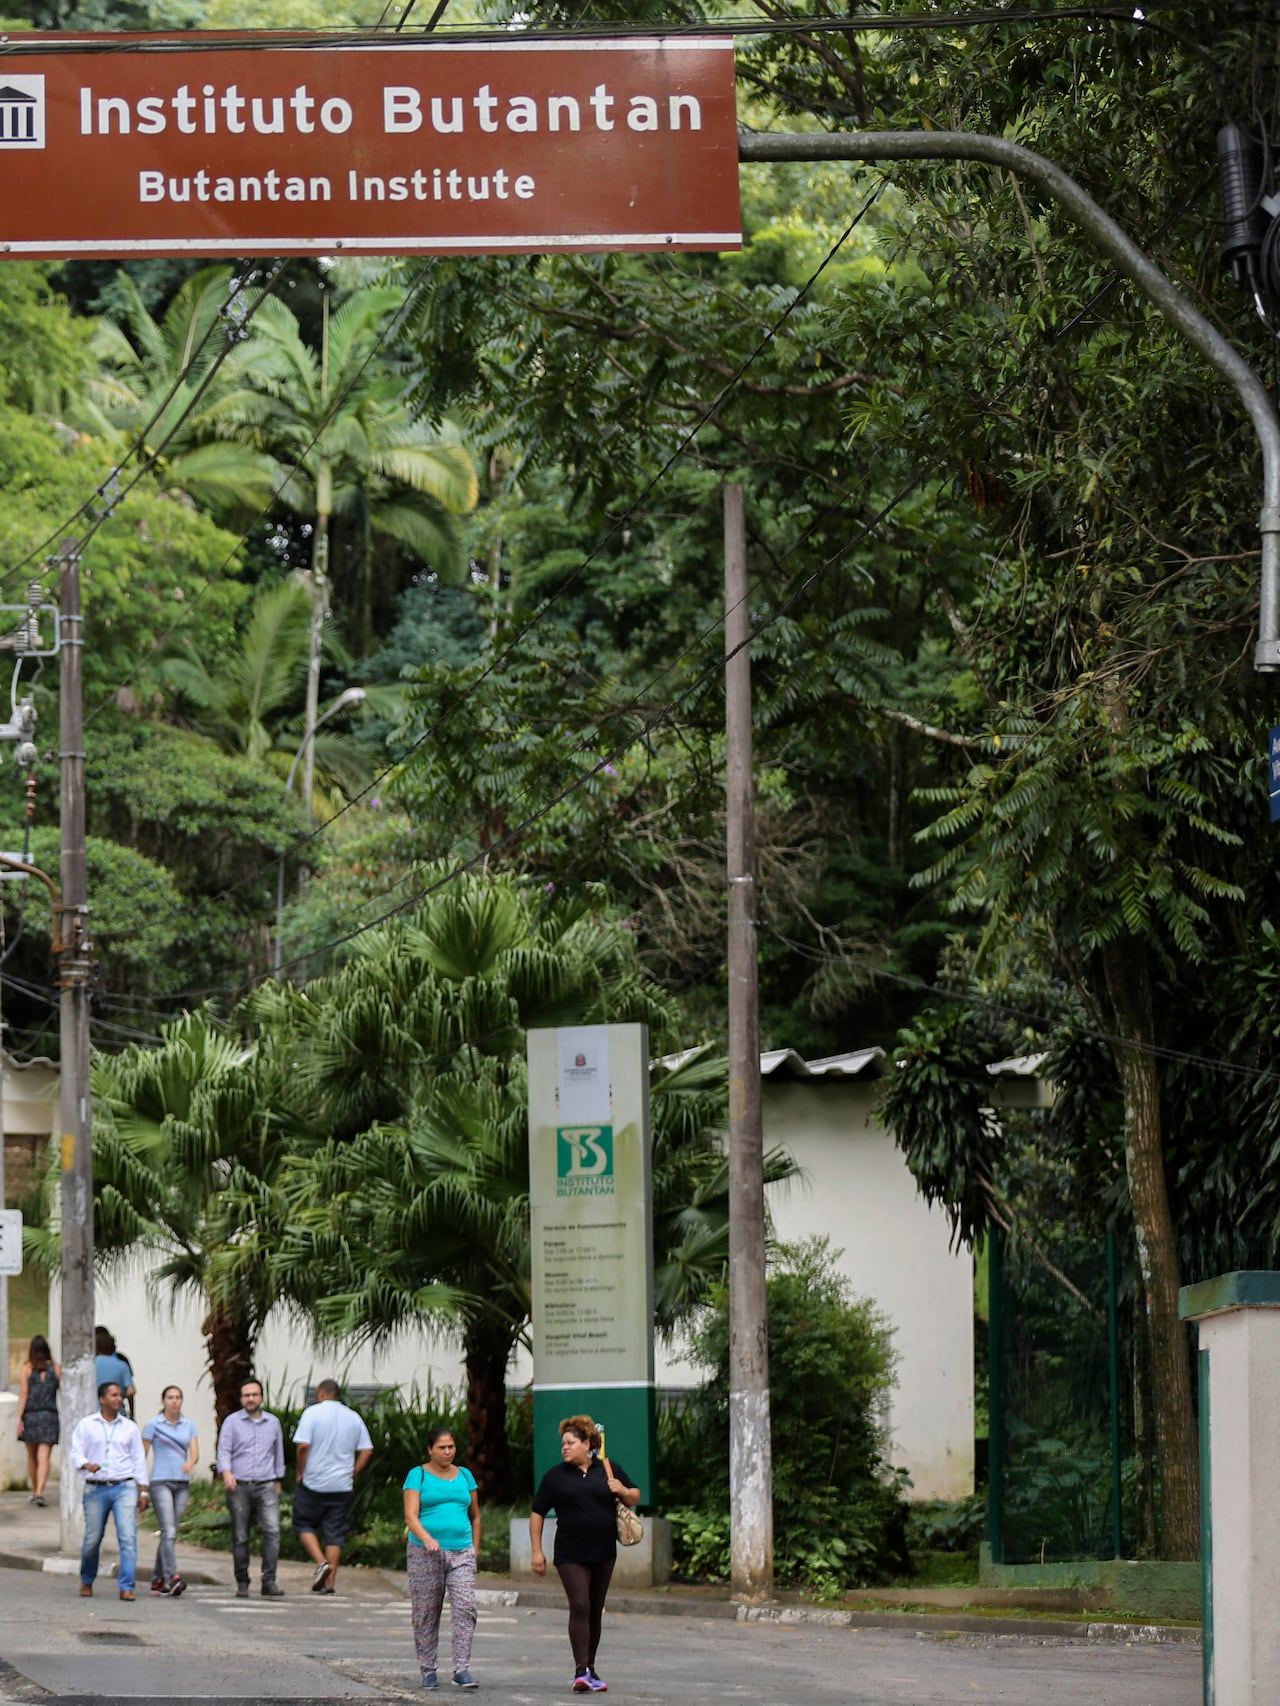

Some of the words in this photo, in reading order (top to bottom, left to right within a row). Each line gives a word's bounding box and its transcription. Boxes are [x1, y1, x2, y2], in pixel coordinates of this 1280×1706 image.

[81, 84, 353, 135] Instituto
[383, 83, 702, 133] Butantan
[139, 169, 331, 202] Butantan
[349, 168, 535, 201] Institute
[557, 1175, 615, 1187] INSTITUTO
[557, 1185, 615, 1197] BUTANTAN
